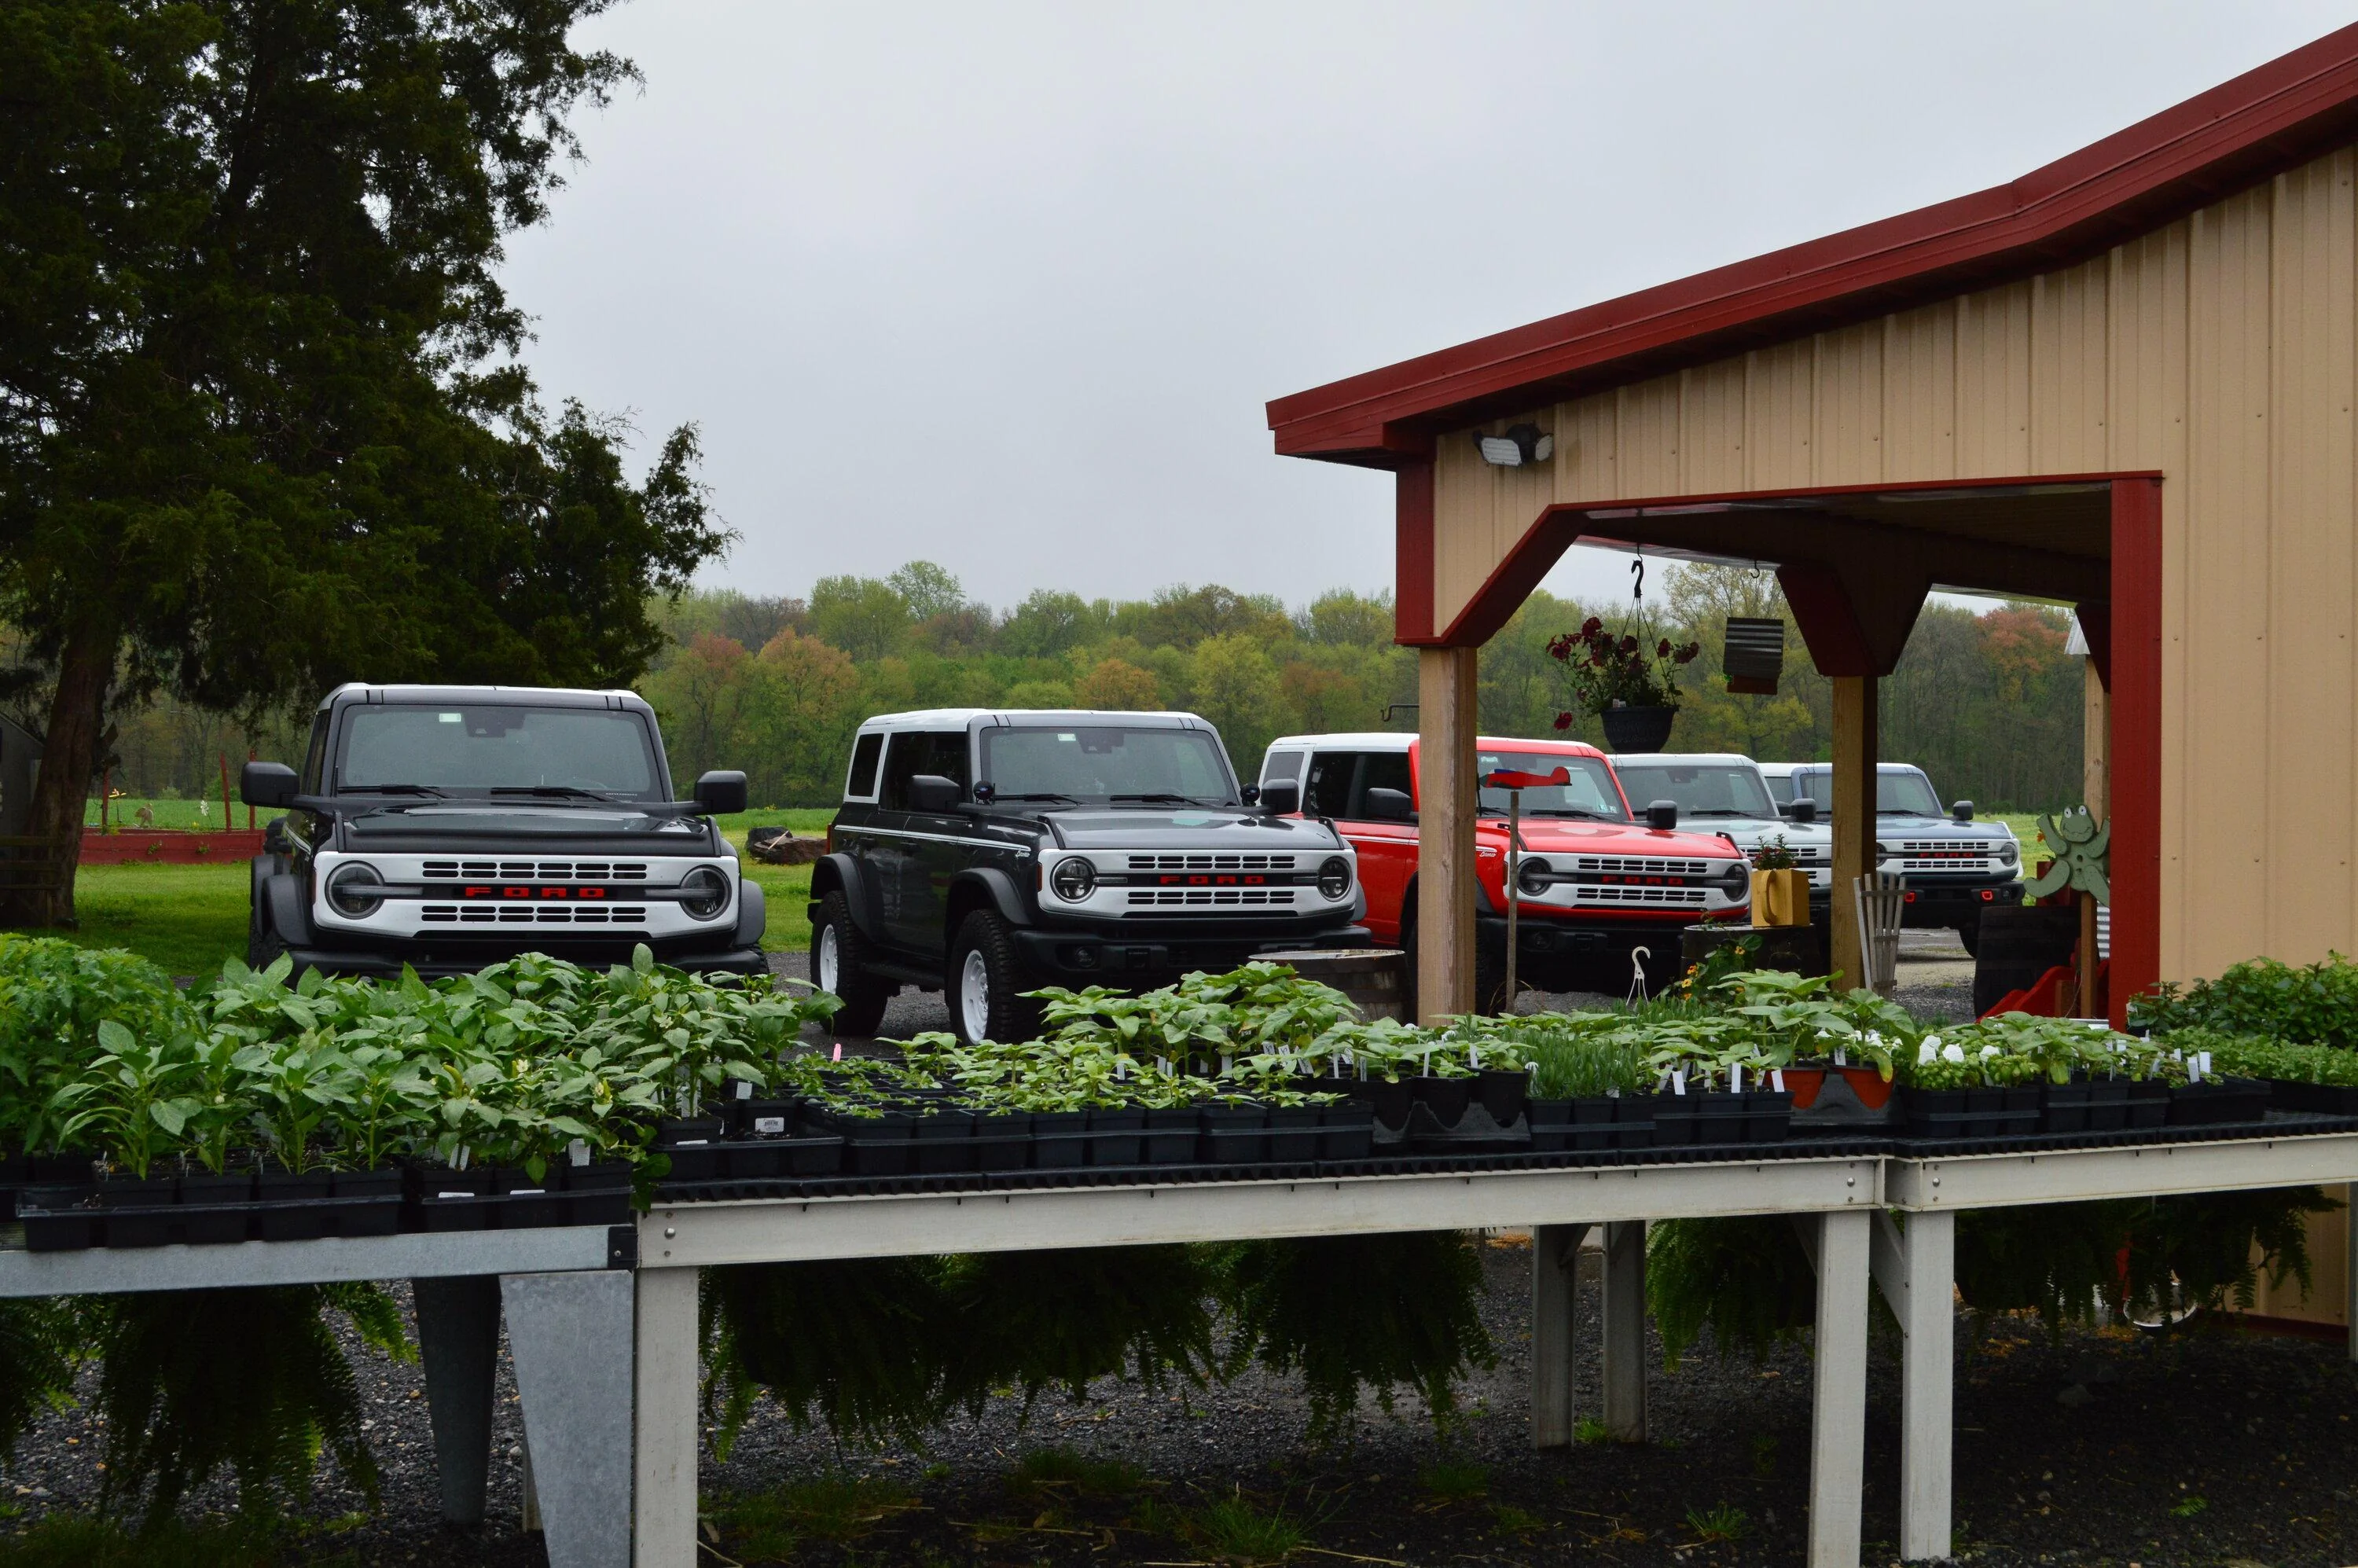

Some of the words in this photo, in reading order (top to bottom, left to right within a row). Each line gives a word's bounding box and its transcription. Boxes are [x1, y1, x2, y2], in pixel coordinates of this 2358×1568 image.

[1159, 876, 1265, 884] FORD
[1602, 876, 1684, 886] FORD
[465, 887, 604, 898] FORD
